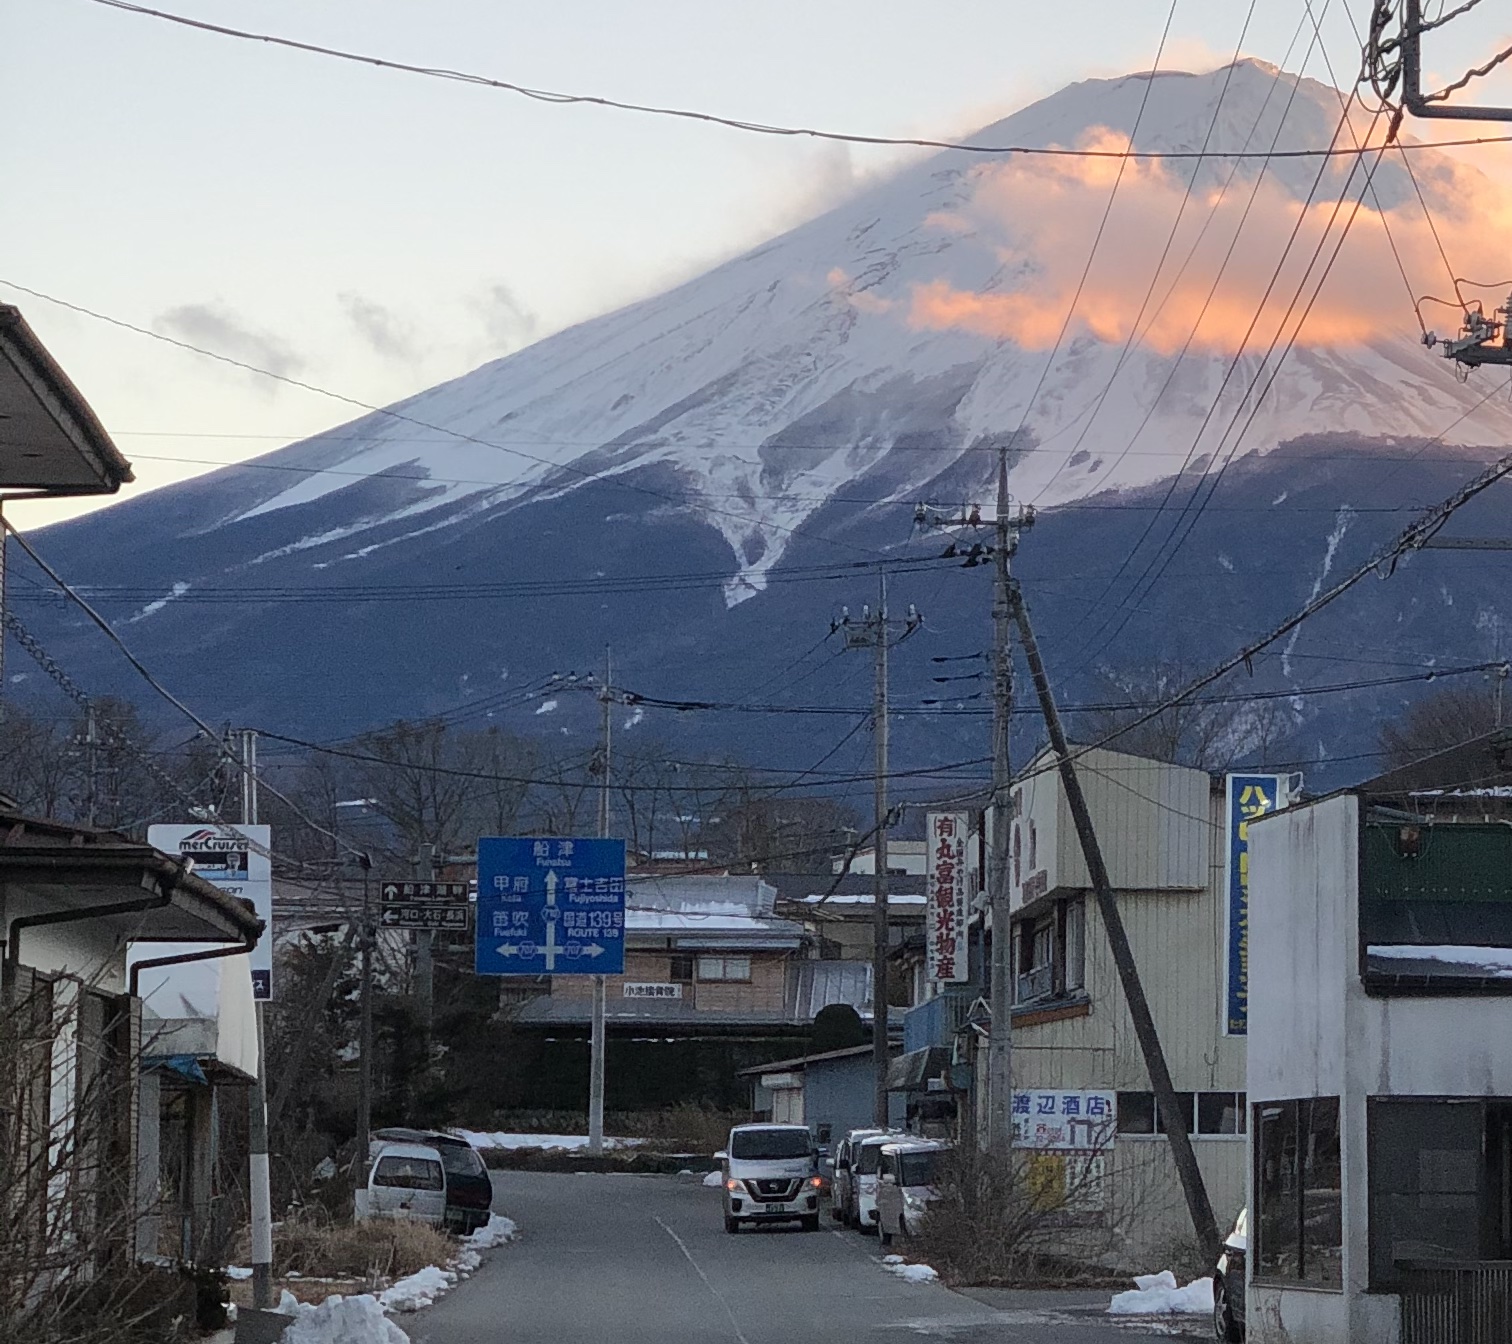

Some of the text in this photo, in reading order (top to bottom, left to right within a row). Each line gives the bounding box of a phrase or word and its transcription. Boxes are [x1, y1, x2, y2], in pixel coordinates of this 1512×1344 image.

[533, 841, 574, 857] 船津
[494, 875, 529, 892] 甲府
[564, 877, 623, 893] 富士吉田
[569, 894, 618, 904] Fujiyoshida
[493, 911, 529, 927] 笛吹
[564, 911, 623, 927] 国道139号
[568, 928, 619, 938] ROUTE 139
